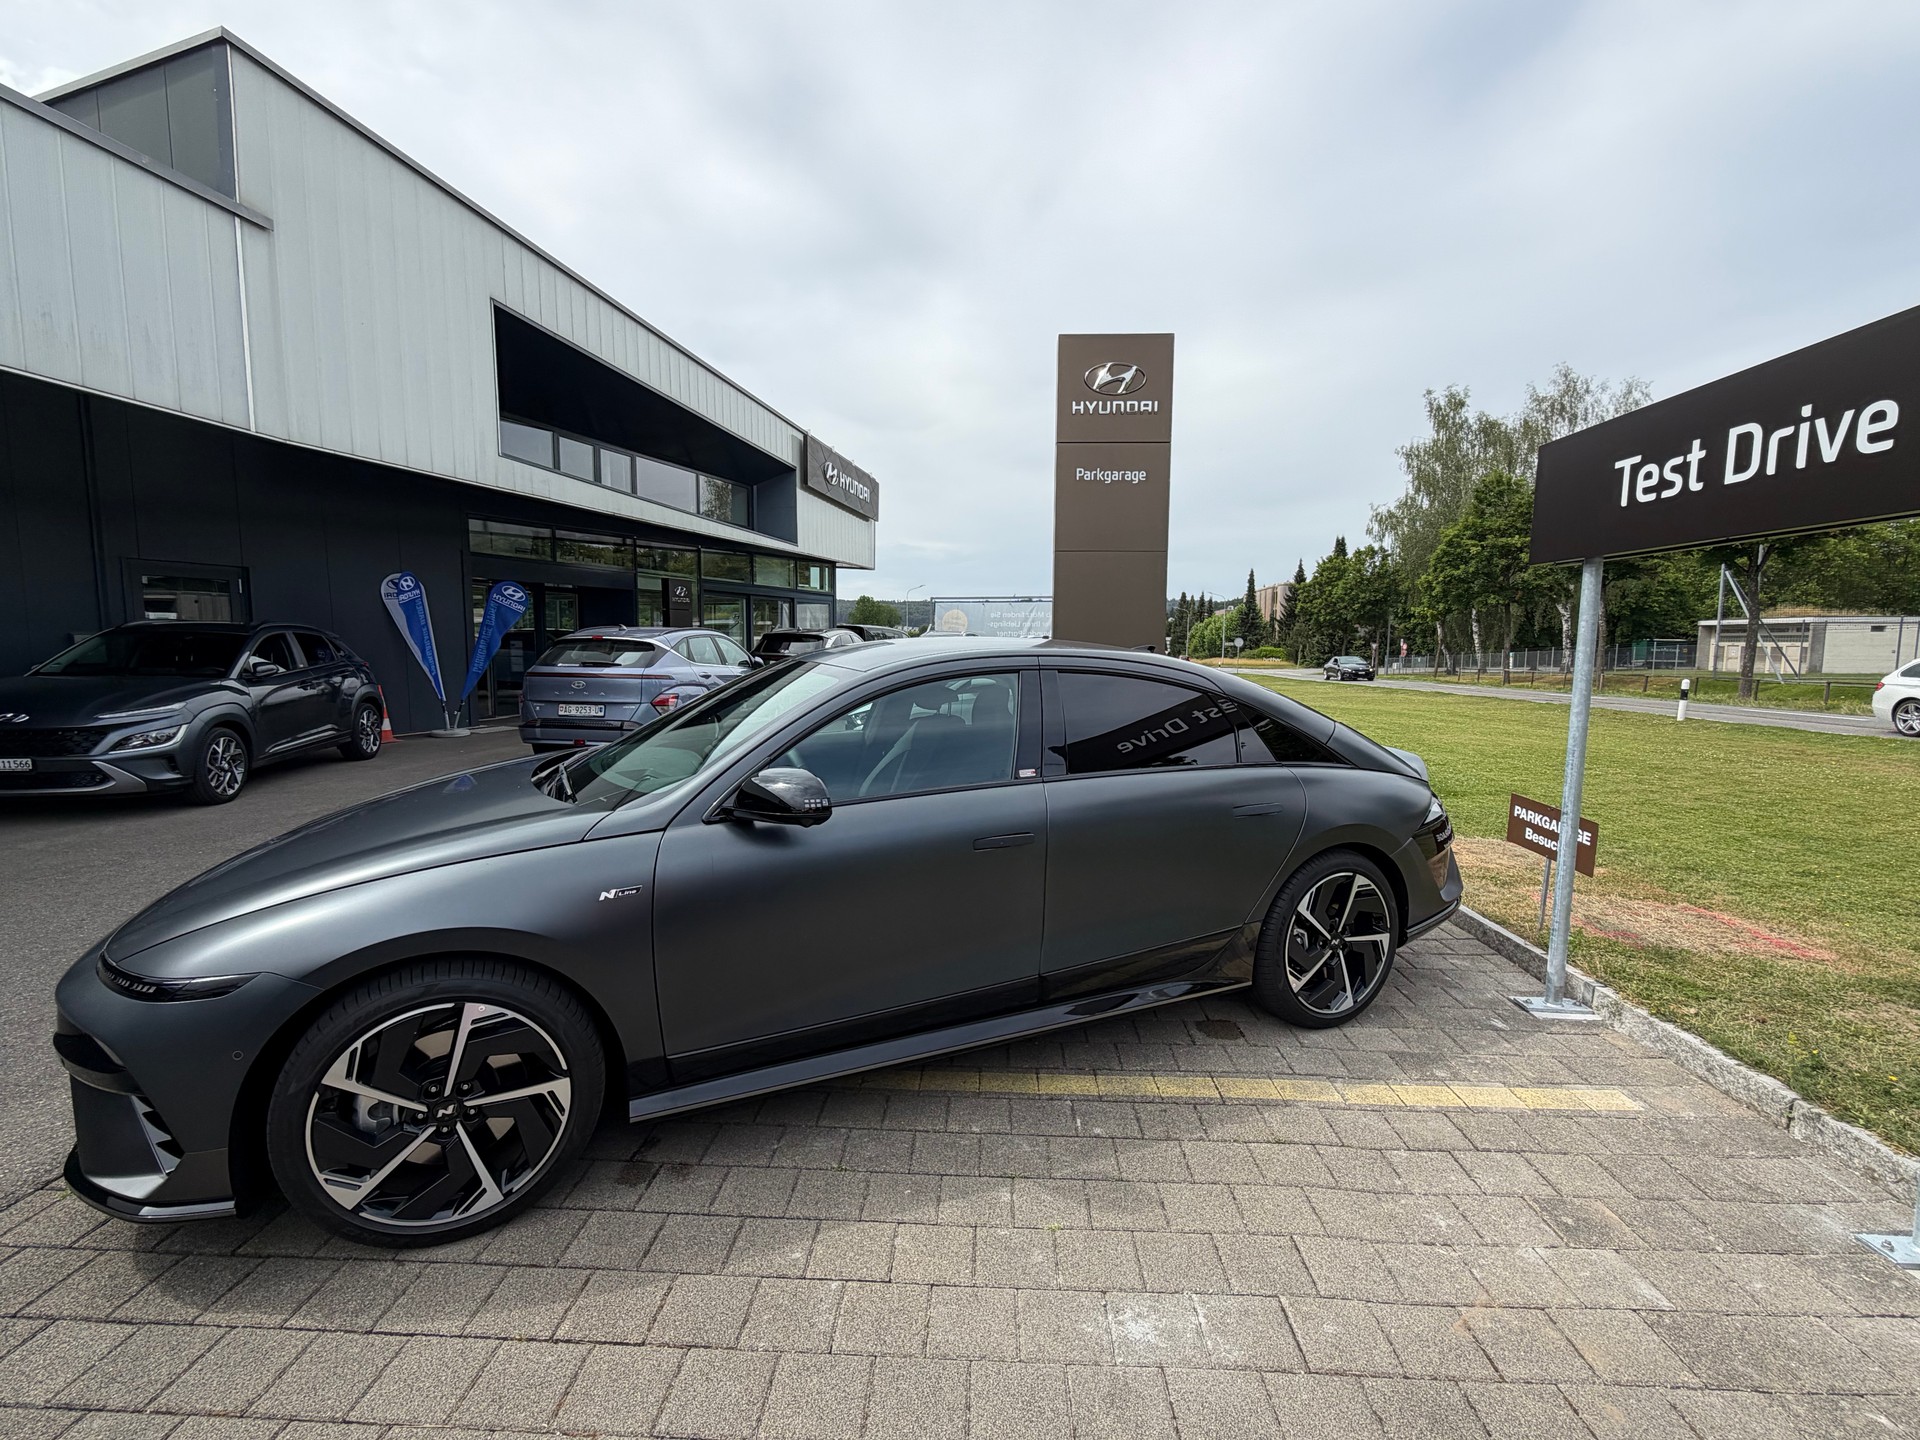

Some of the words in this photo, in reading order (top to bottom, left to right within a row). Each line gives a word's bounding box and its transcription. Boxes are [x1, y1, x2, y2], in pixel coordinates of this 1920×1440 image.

[1072, 400, 1158, 414] HYUNDAI
[1614, 438, 1707, 507] Test
[1724, 399, 1900, 485] Drive
[1075, 467, 1147, 484] Parkgarage
[839, 471, 871, 503] HYUNDAI
[492, 593, 526, 611] HYUNDAI
